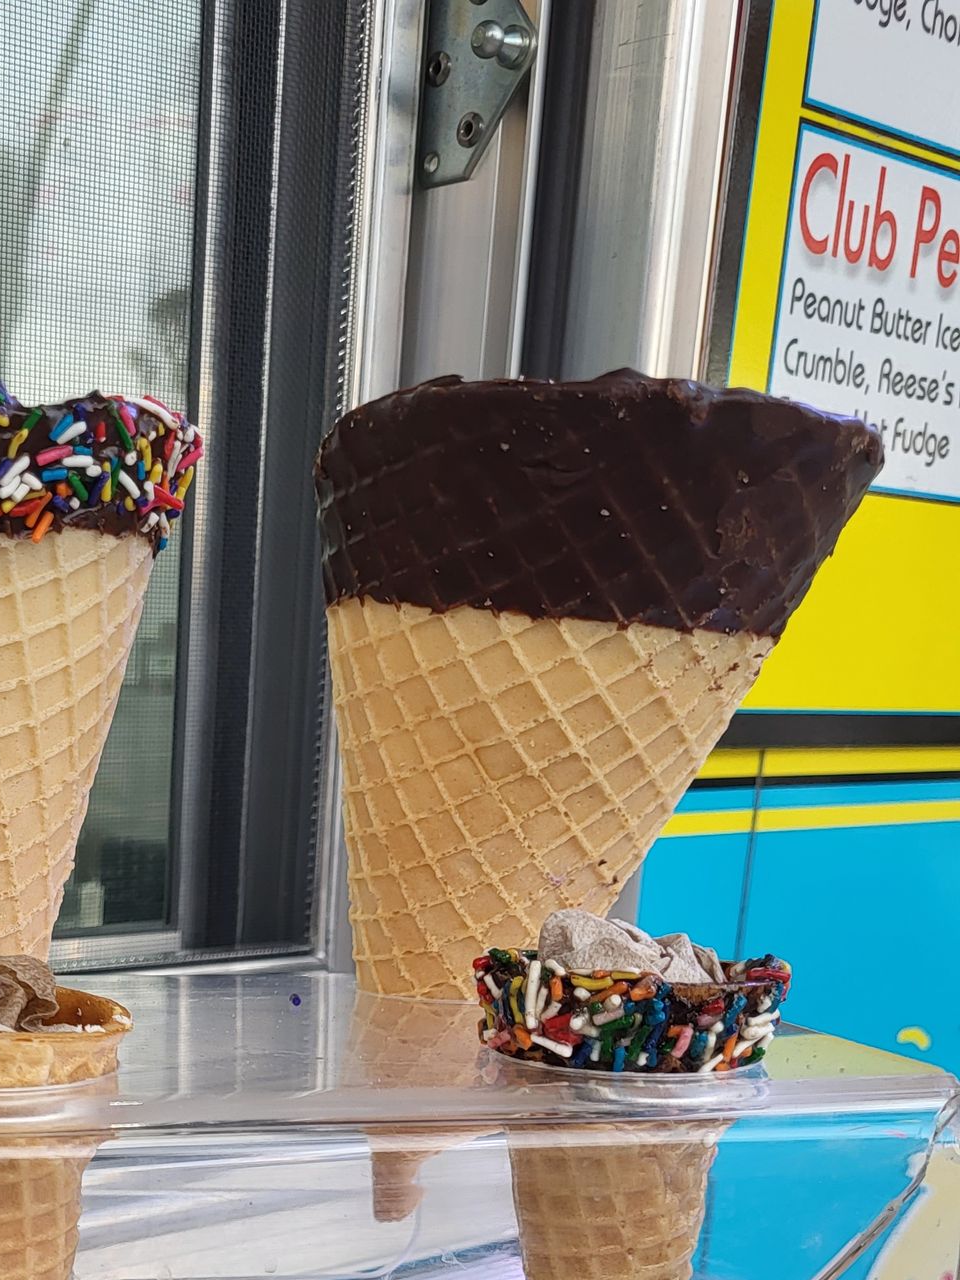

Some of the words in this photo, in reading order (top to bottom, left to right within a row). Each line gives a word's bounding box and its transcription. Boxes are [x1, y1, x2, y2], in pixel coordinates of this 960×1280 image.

[921, 0, 960, 47] Cho
[799, 153, 898, 271] Club
[790, 277, 865, 330] Peanut
[870, 297, 932, 346] Butter
[935, 313, 960, 352] Ice
[784, 338, 870, 395] Crumble,
[878, 358, 955, 406] Reese's
